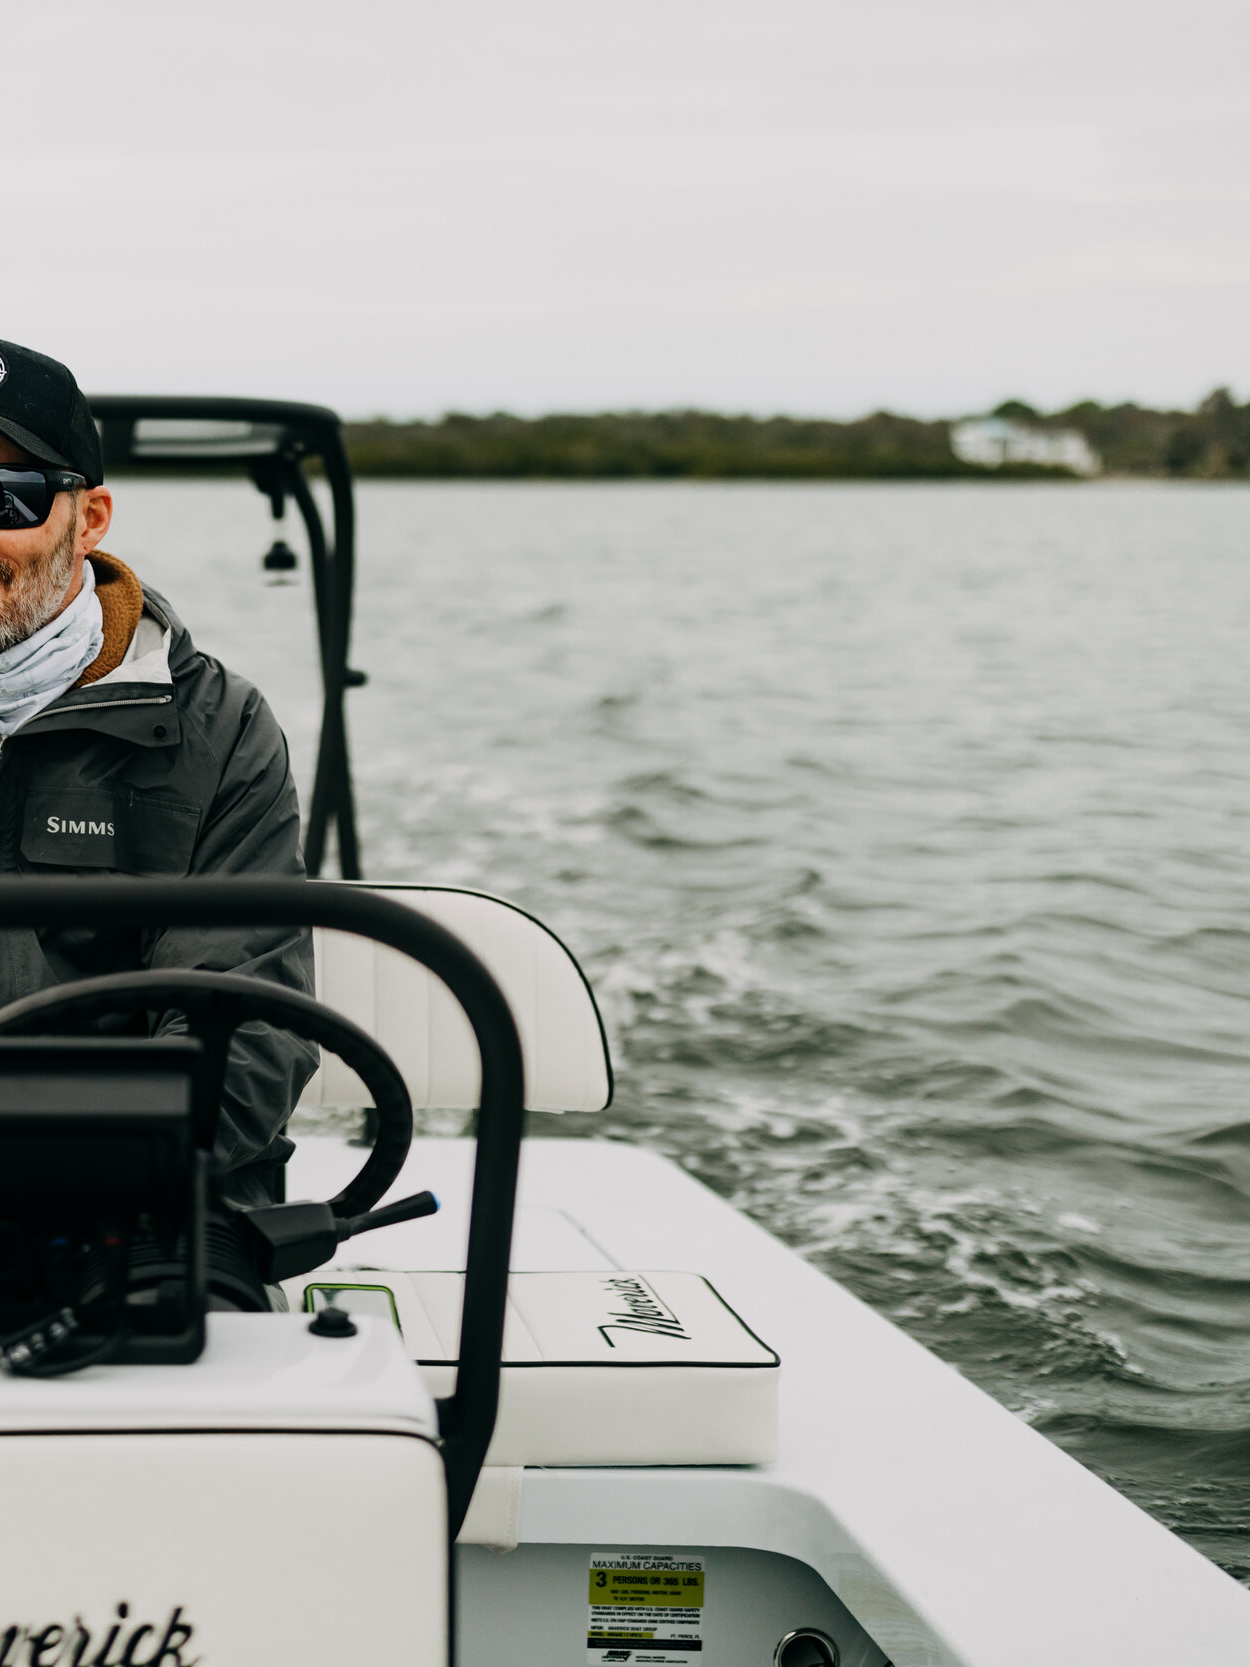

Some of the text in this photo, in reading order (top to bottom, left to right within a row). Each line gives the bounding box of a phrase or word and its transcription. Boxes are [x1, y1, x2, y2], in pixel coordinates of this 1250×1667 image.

[597, 1274, 692, 1348] Maverick
[592, 1560, 702, 1571] MAXIMUM CAPACITIES
[595, 1571, 607, 1587] 3
[612, 1576, 648, 1585] PERSONS
[650, 1577, 661, 1585] OR
[682, 1577, 699, 1586] LBS.
